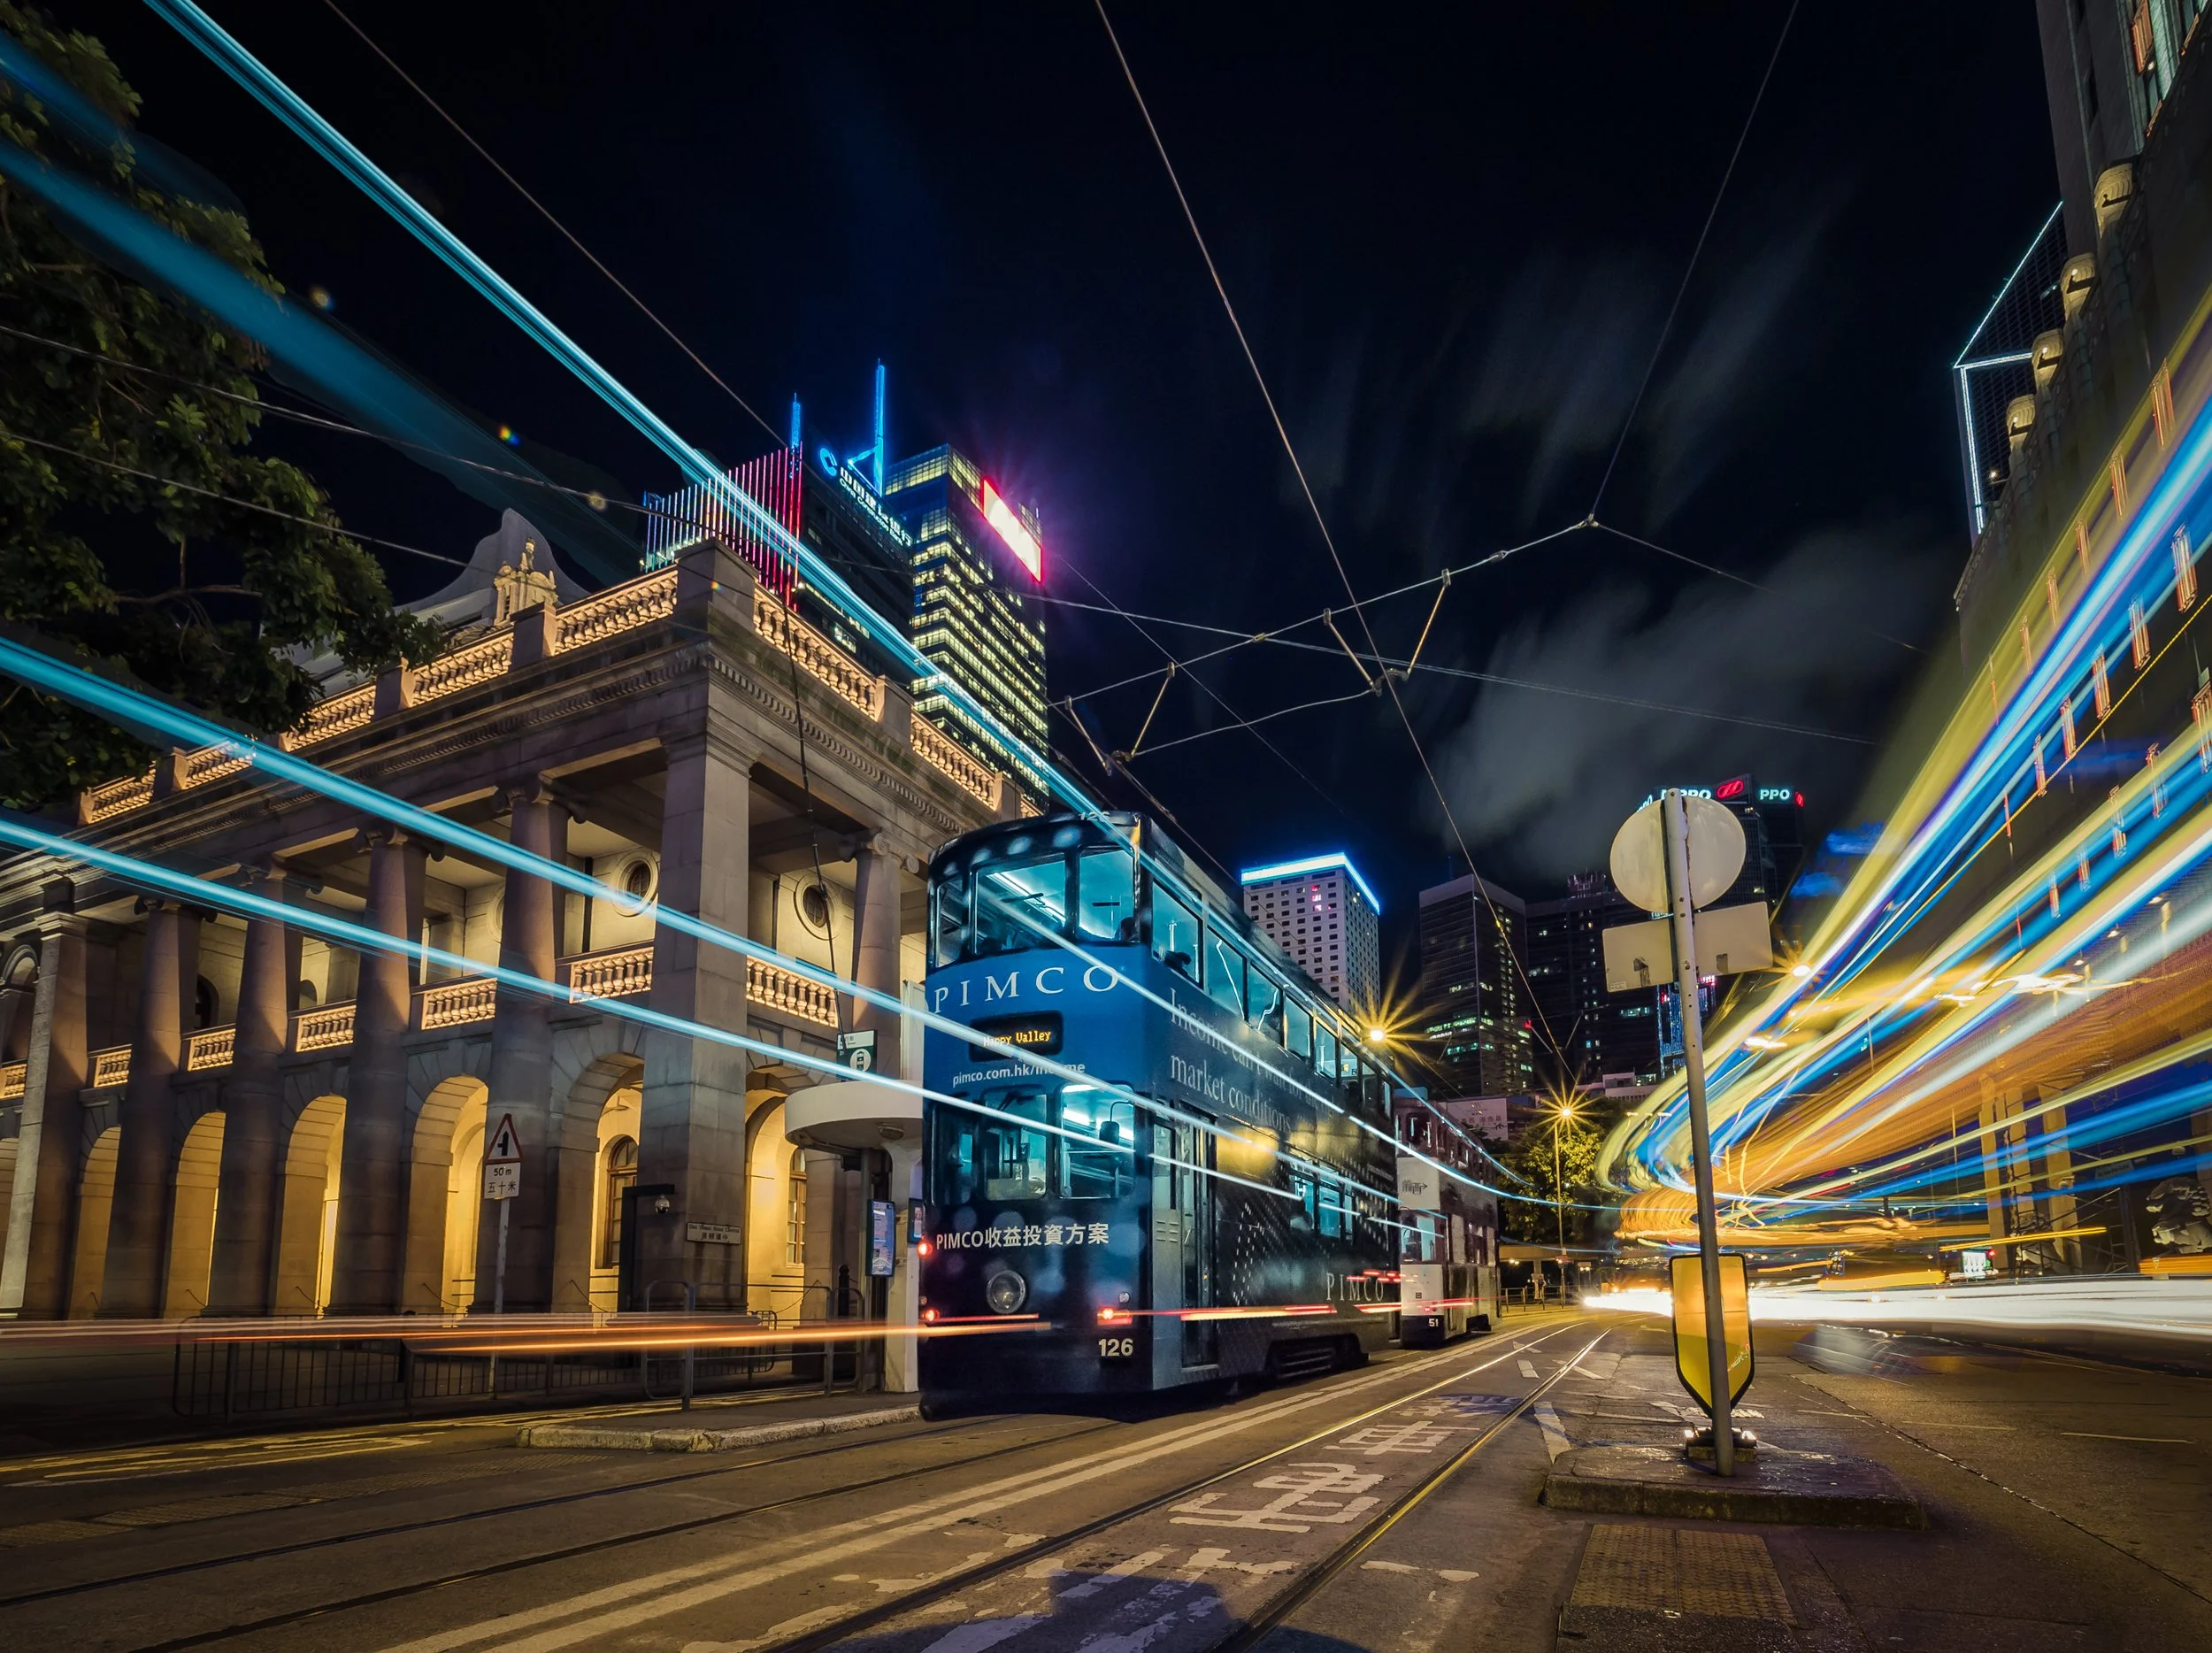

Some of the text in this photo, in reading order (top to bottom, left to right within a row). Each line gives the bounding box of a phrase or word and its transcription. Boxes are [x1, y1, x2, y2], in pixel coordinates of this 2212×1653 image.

[933, 965, 1119, 1014] PIMCO
[983, 1030, 1052, 1048] Happy Valley
[952, 1063, 1086, 1088] pimco.com.hk/incme
[1171, 1055, 1225, 1103] market
[1228, 1087, 1292, 1133] conditions
[493, 1167, 504, 1177] 50
[487, 1180, 518, 1195] 五十米
[935, 1222, 1110, 1250] PIMCO收益投資方案
[1326, 1272, 1384, 1301] PIMCO
[1428, 1318, 1439, 1327] 51
[1098, 1338, 1133, 1357] 126
